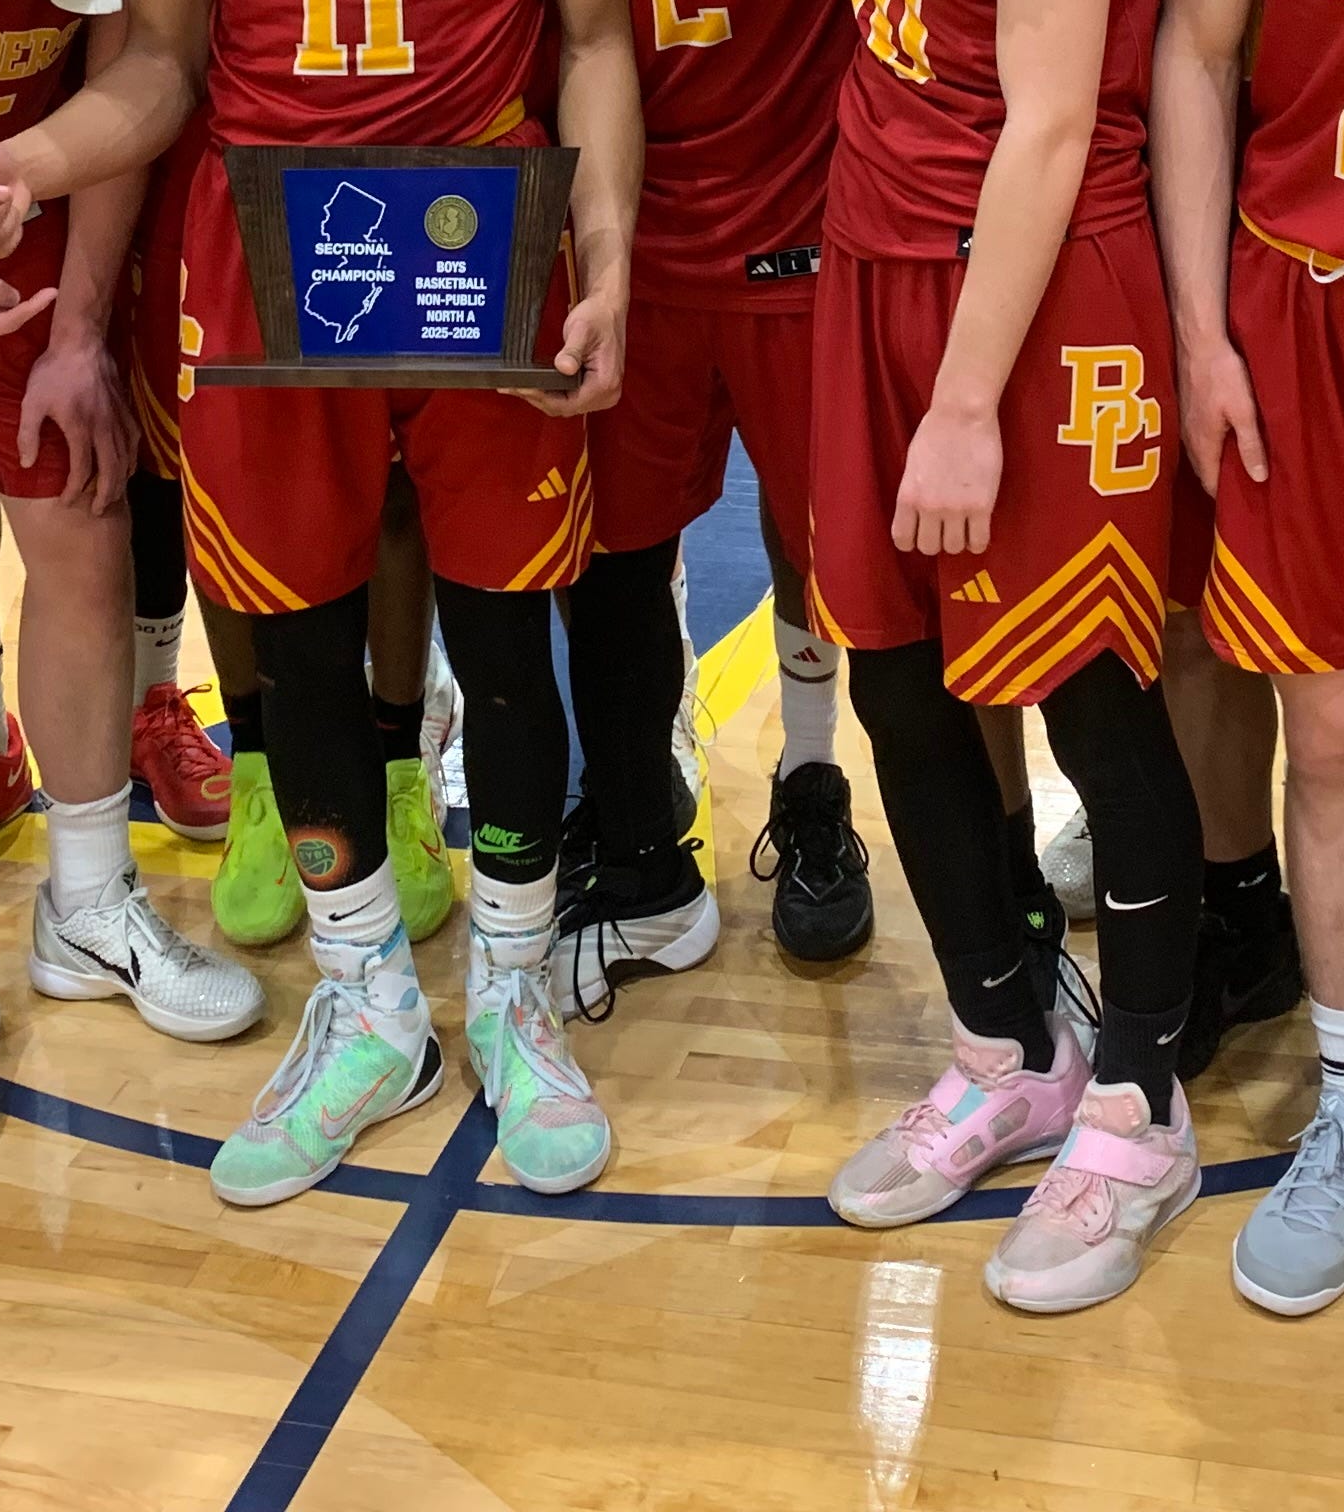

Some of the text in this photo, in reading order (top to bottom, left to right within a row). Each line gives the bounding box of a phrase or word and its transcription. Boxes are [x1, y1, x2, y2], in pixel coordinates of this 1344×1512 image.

[314, 241, 393, 256] SECTIONAL
[436, 260, 467, 274] BOYS
[311, 268, 395, 283] CHAMPIONS
[414, 276, 488, 291] BASKETBALL
[416, 293, 486, 307] NON-PUBLIC
[425, 310, 475, 323] NORTH A
[420, 326, 481, 340] 2025-2026
[1058, 344, 1163, 496] BC
[479, 823, 524, 848] NIKE
